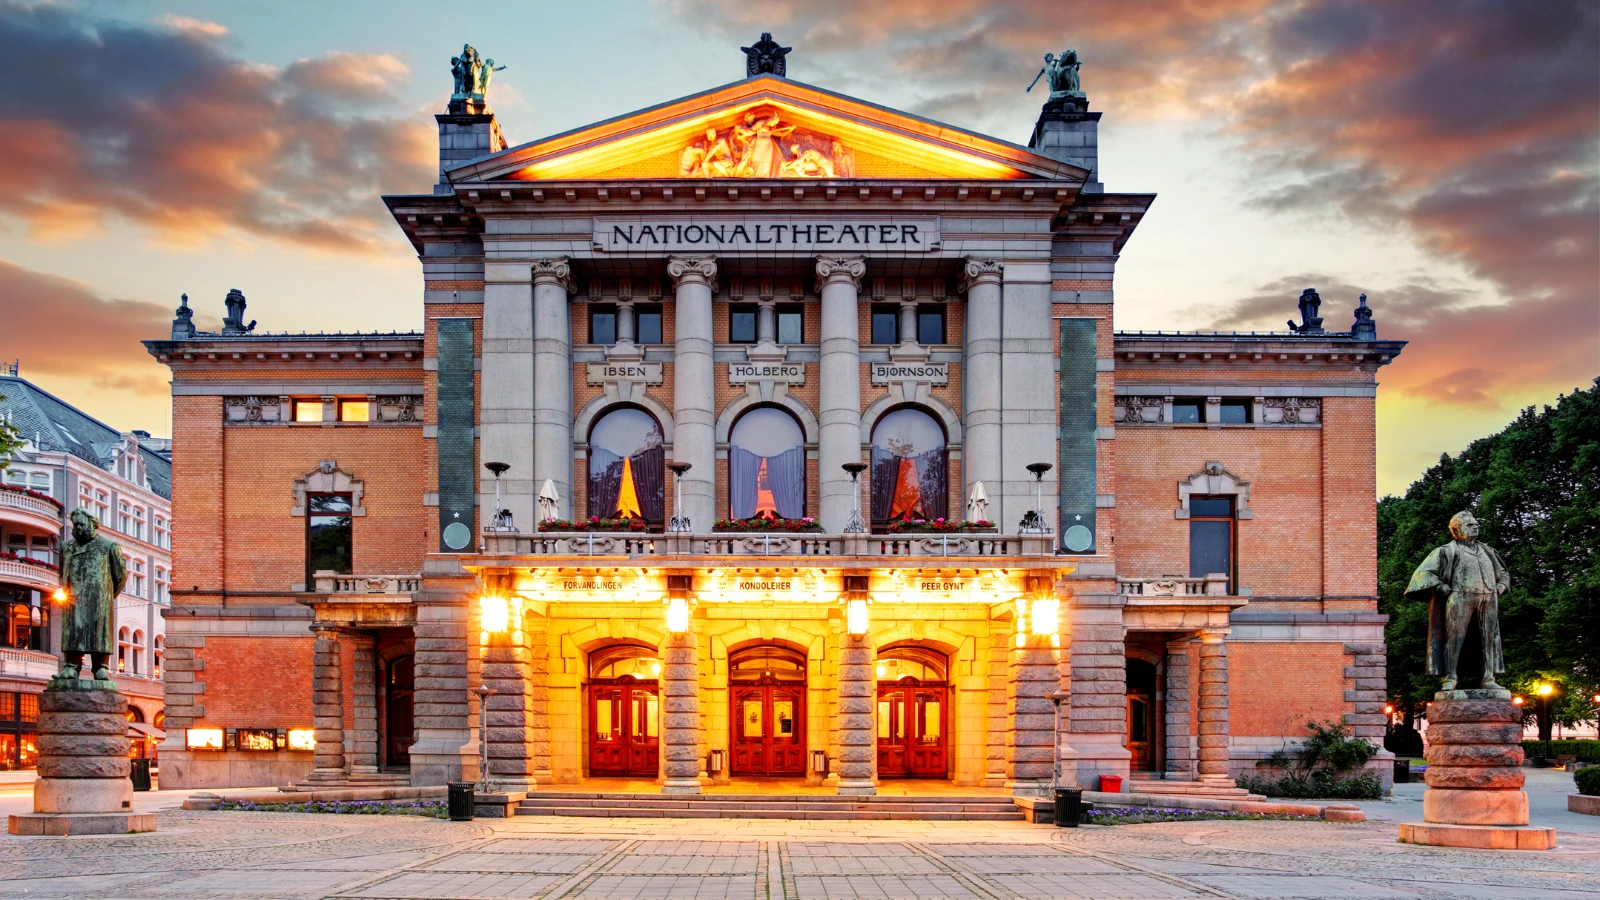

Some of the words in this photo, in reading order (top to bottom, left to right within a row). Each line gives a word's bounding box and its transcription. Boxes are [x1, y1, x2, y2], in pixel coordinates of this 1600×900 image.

[613, 224, 920, 244] NATIONALTHEATER
[603, 367, 646, 377] IBSEN
[736, 366, 799, 377] HOLBERG
[877, 367, 944, 378] BJØRNSON
[563, 581, 622, 589] FORVANDLINGEN
[740, 581, 791, 590] KONDOLERER
[921, 582, 941, 591] PEER
[943, 582, 964, 591] GYNT
